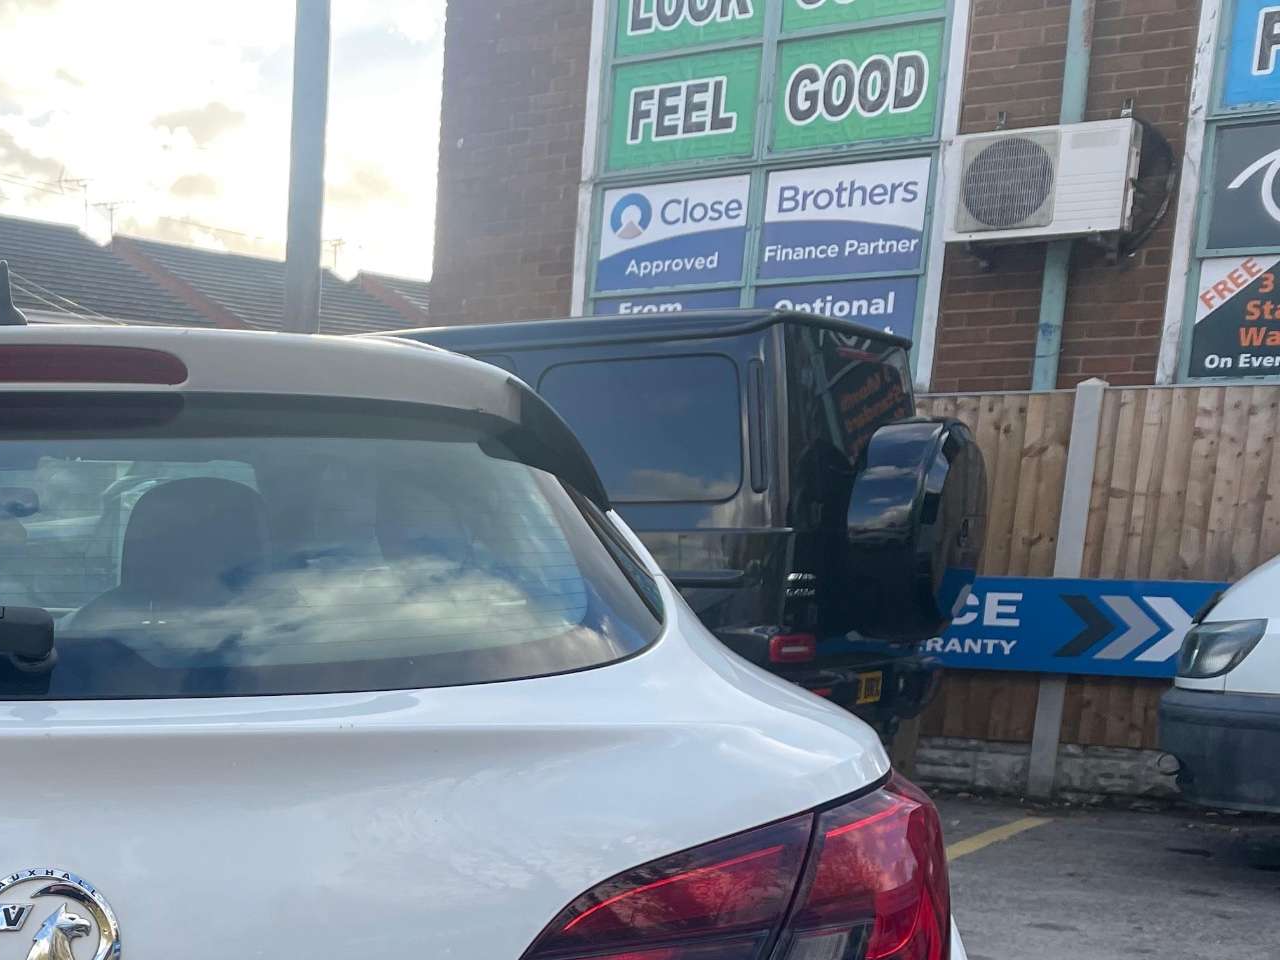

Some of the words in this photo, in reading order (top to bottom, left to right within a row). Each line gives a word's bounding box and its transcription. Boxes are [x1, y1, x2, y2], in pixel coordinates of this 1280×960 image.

[627, 76, 737, 144] FEEL
[785, 51, 928, 125] GOOD
[660, 198, 743, 226] Close
[777, 179, 919, 213] Brothers
[764, 243, 839, 263] Finance
[844, 238, 919, 257] Partner
[625, 252, 718, 277] Approved
[1199, 257, 1263, 311] FREE
[1258, 272, 1275, 293] 3
[1204, 354, 1232, 369] On
[919, 637, 1017, 655] RANTY
